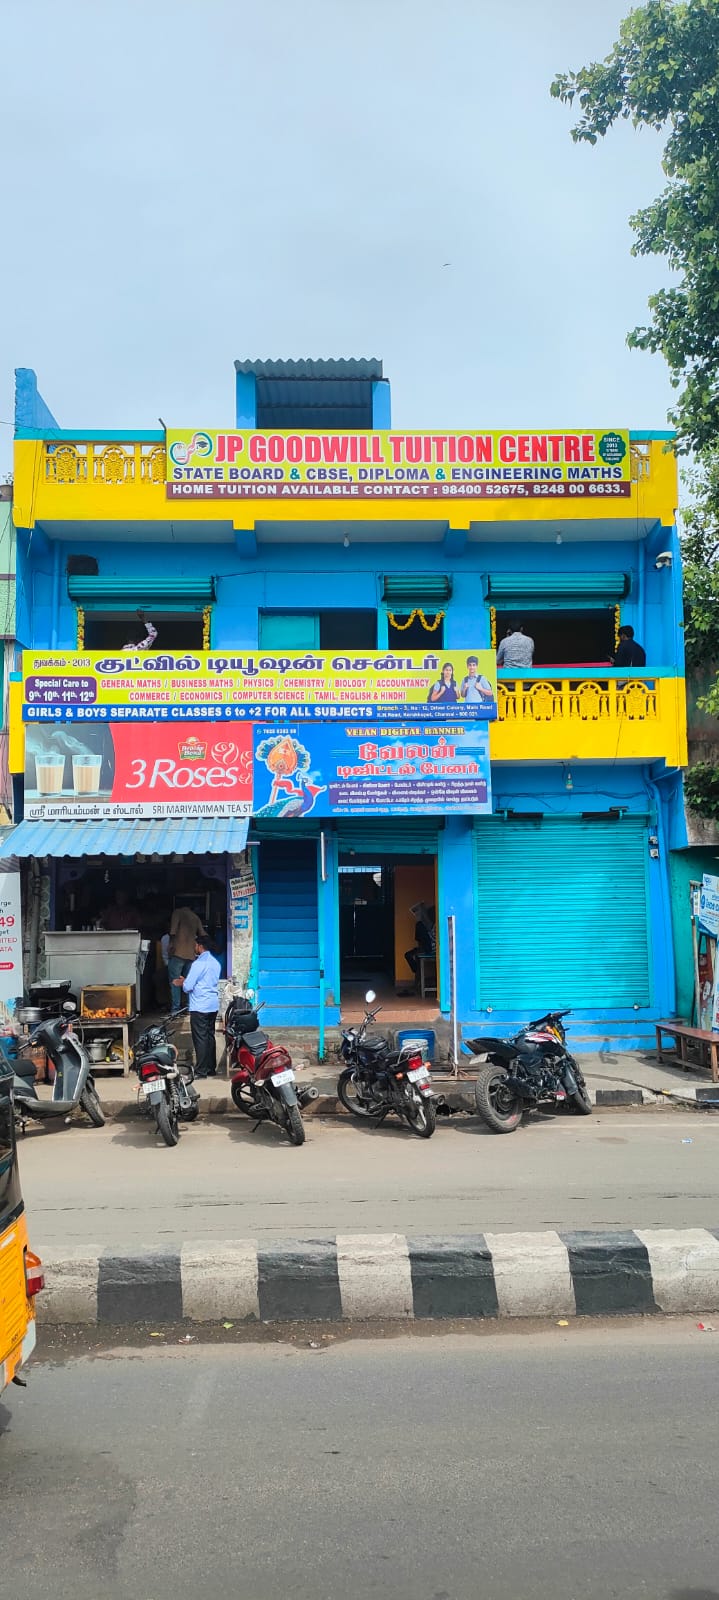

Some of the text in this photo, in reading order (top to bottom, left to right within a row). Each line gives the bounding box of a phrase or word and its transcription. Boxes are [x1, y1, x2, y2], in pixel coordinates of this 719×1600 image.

[215, 435, 595, 463] JP GOODWILL TUITION CENTRE
[173, 467, 622, 482] STATE BOARD & CBSE, DIPLOMA & ENGINEERING MATHS
[172, 484, 213, 494] HOME
[218, 484, 277, 495] TUITION
[281, 484, 359, 495] AVAILABLE
[363, 485, 430, 495] CONTACT
[441, 485, 482, 495] 98400
[485, 485, 529, 496] 52675,
[533, 485, 565, 494] 8248
[568, 485, 585, 494] 00
[588, 484, 624, 494] 6633.
[72, 658, 91, 667] 2013
[95, 655, 439, 676] குட்வில் டியூஷன் சென்டர்
[34, 679, 89, 689] Special Care to
[101, 679, 134, 688] GENERAL
[136, 679, 161, 688] MATHS
[171, 679, 207, 688] BUSINESS
[209, 679, 234, 688] MATHS
[243, 679, 274, 688] PHYSICS
[284, 679, 325, 688] CHEMISTRY
[334, 679, 366, 688] BIOLOGY
[376, 679, 430, 688] ACCOUNTANCY
[79, 690, 95, 702] 12th
[129, 692, 170, 700] COMMERCE
[180, 692, 223, 700] ECONOMICS
[232, 692, 273, 700] COMPUTER
[274, 691, 305, 700] SCIENCE
[340, 691, 371, 700] ENGLISH
[373, 692, 379, 700] &
[380, 691, 406, 700] HINDHI
[27, 706, 373, 717] GIRLS & BOYS SEPARATE CLASSES 6 to +2 FOR ALL SUBJECTS
[345, 727, 465, 737] VELAN DIGITAL BANNER
[358, 737, 457, 760] வேலன்
[125, 758, 239, 788] 3 Roses
[337, 761, 479, 779] டிஜிட்டல் பேனர்
[47, 804, 100, 816] மாரியம்மன்
[152, 803, 252, 814] SRI MARIYAMMAN TEA ST
